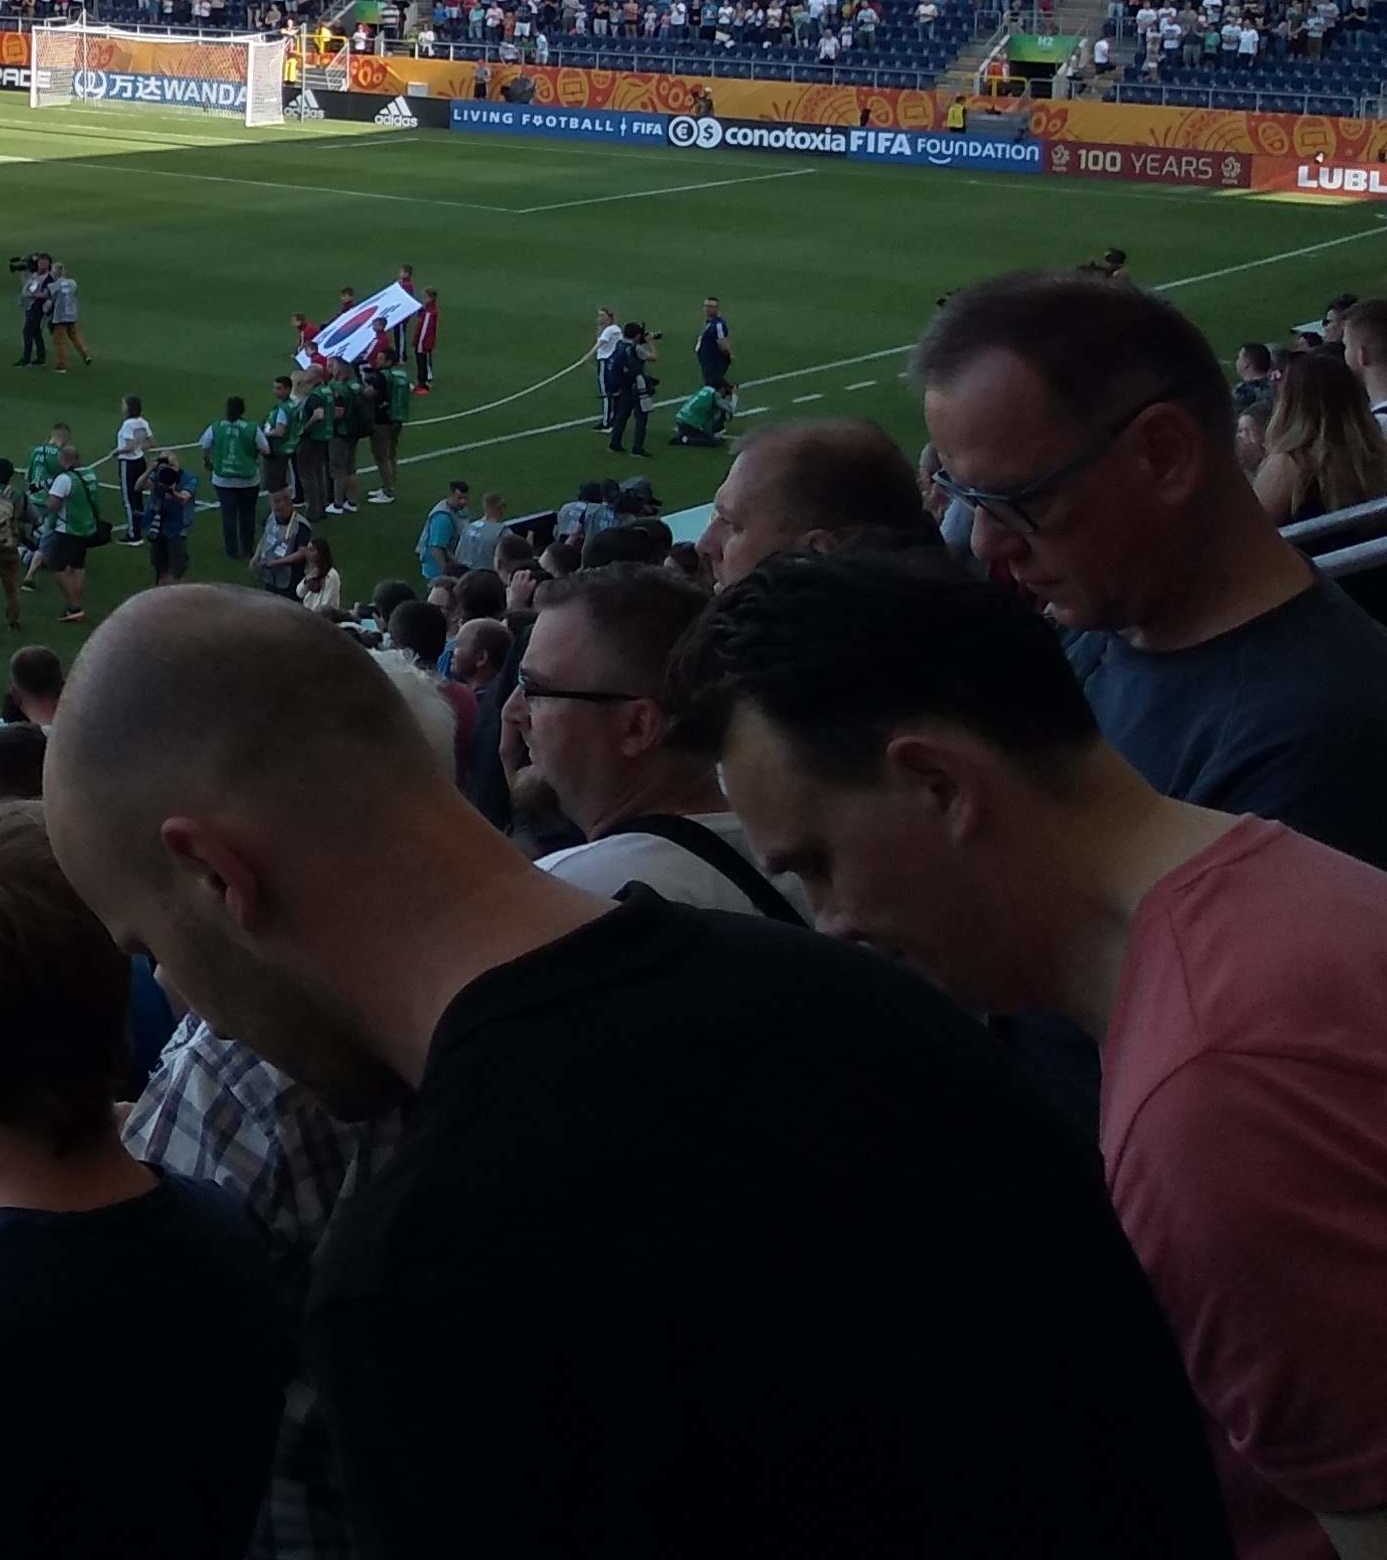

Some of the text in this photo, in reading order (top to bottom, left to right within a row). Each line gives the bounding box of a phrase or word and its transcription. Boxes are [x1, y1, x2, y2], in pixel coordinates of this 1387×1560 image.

[110, 74, 161, 101] 万达
[163, 80, 248, 106] WANDA
[284, 106, 325, 120] addas
[374, 113, 418, 128] adidas
[453, 108, 513, 125] LIVING
[632, 121, 663, 136] FIFA
[725, 125, 846, 153] conotoxia
[849, 130, 912, 156] FIFA
[1077, 149, 1212, 180] 100 YEARS
